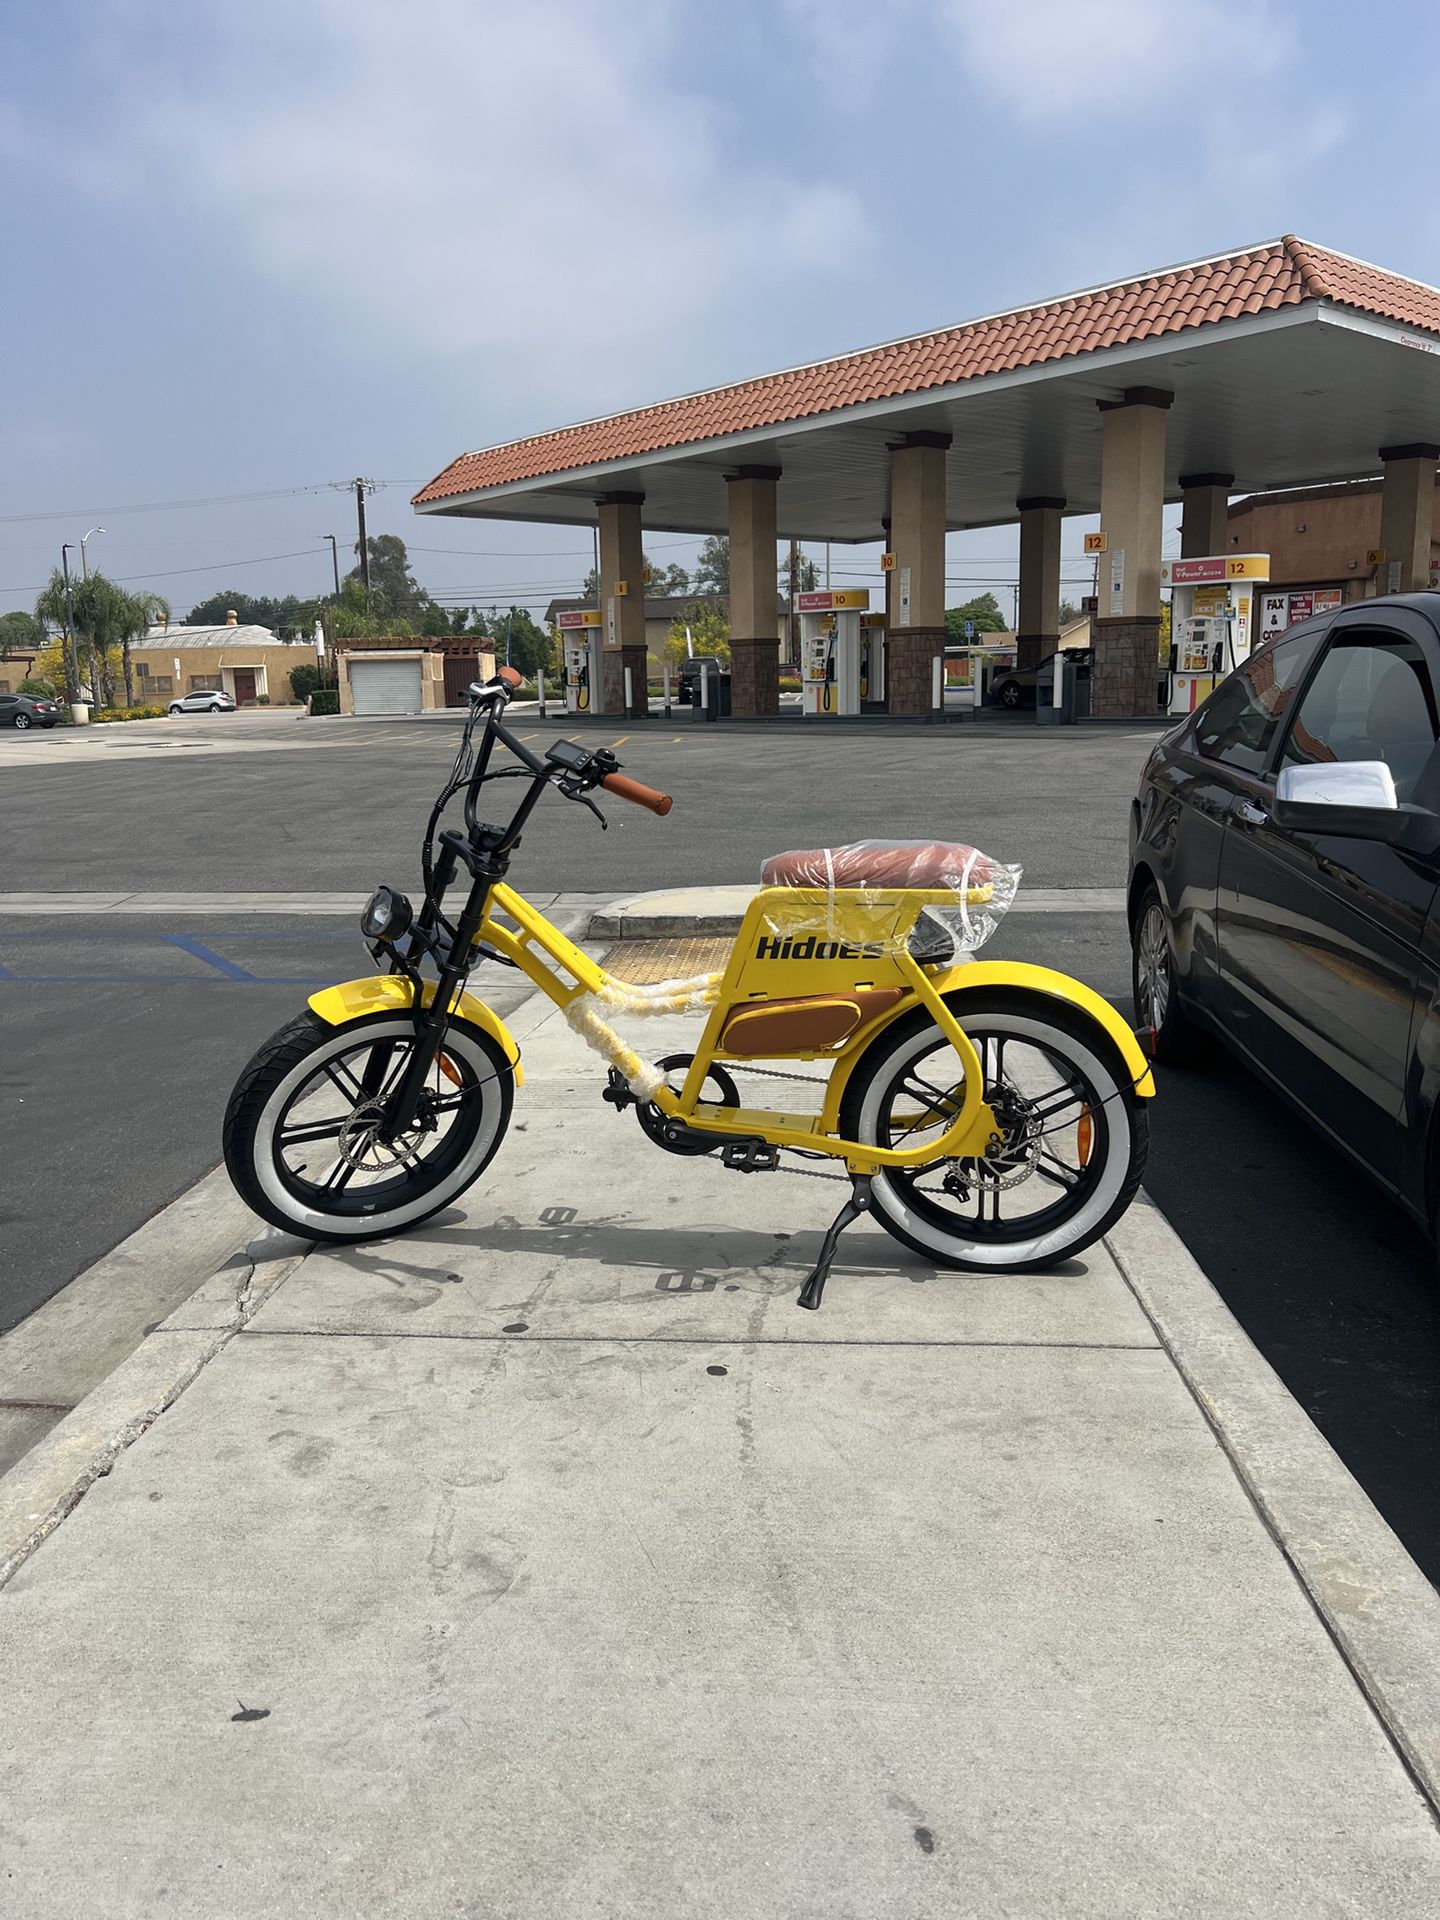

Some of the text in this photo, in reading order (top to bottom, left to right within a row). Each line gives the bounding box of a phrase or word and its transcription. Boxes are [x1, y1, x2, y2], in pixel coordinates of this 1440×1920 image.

[1088, 536, 1102, 548] 12
[883, 557, 893, 567] 10
[1369, 552, 1376, 561] 6
[1230, 563, 1245, 574] 12
[835, 595, 846, 605] 10
[1267, 598, 1284, 610] FAX
[1271, 614, 1278, 625] &
